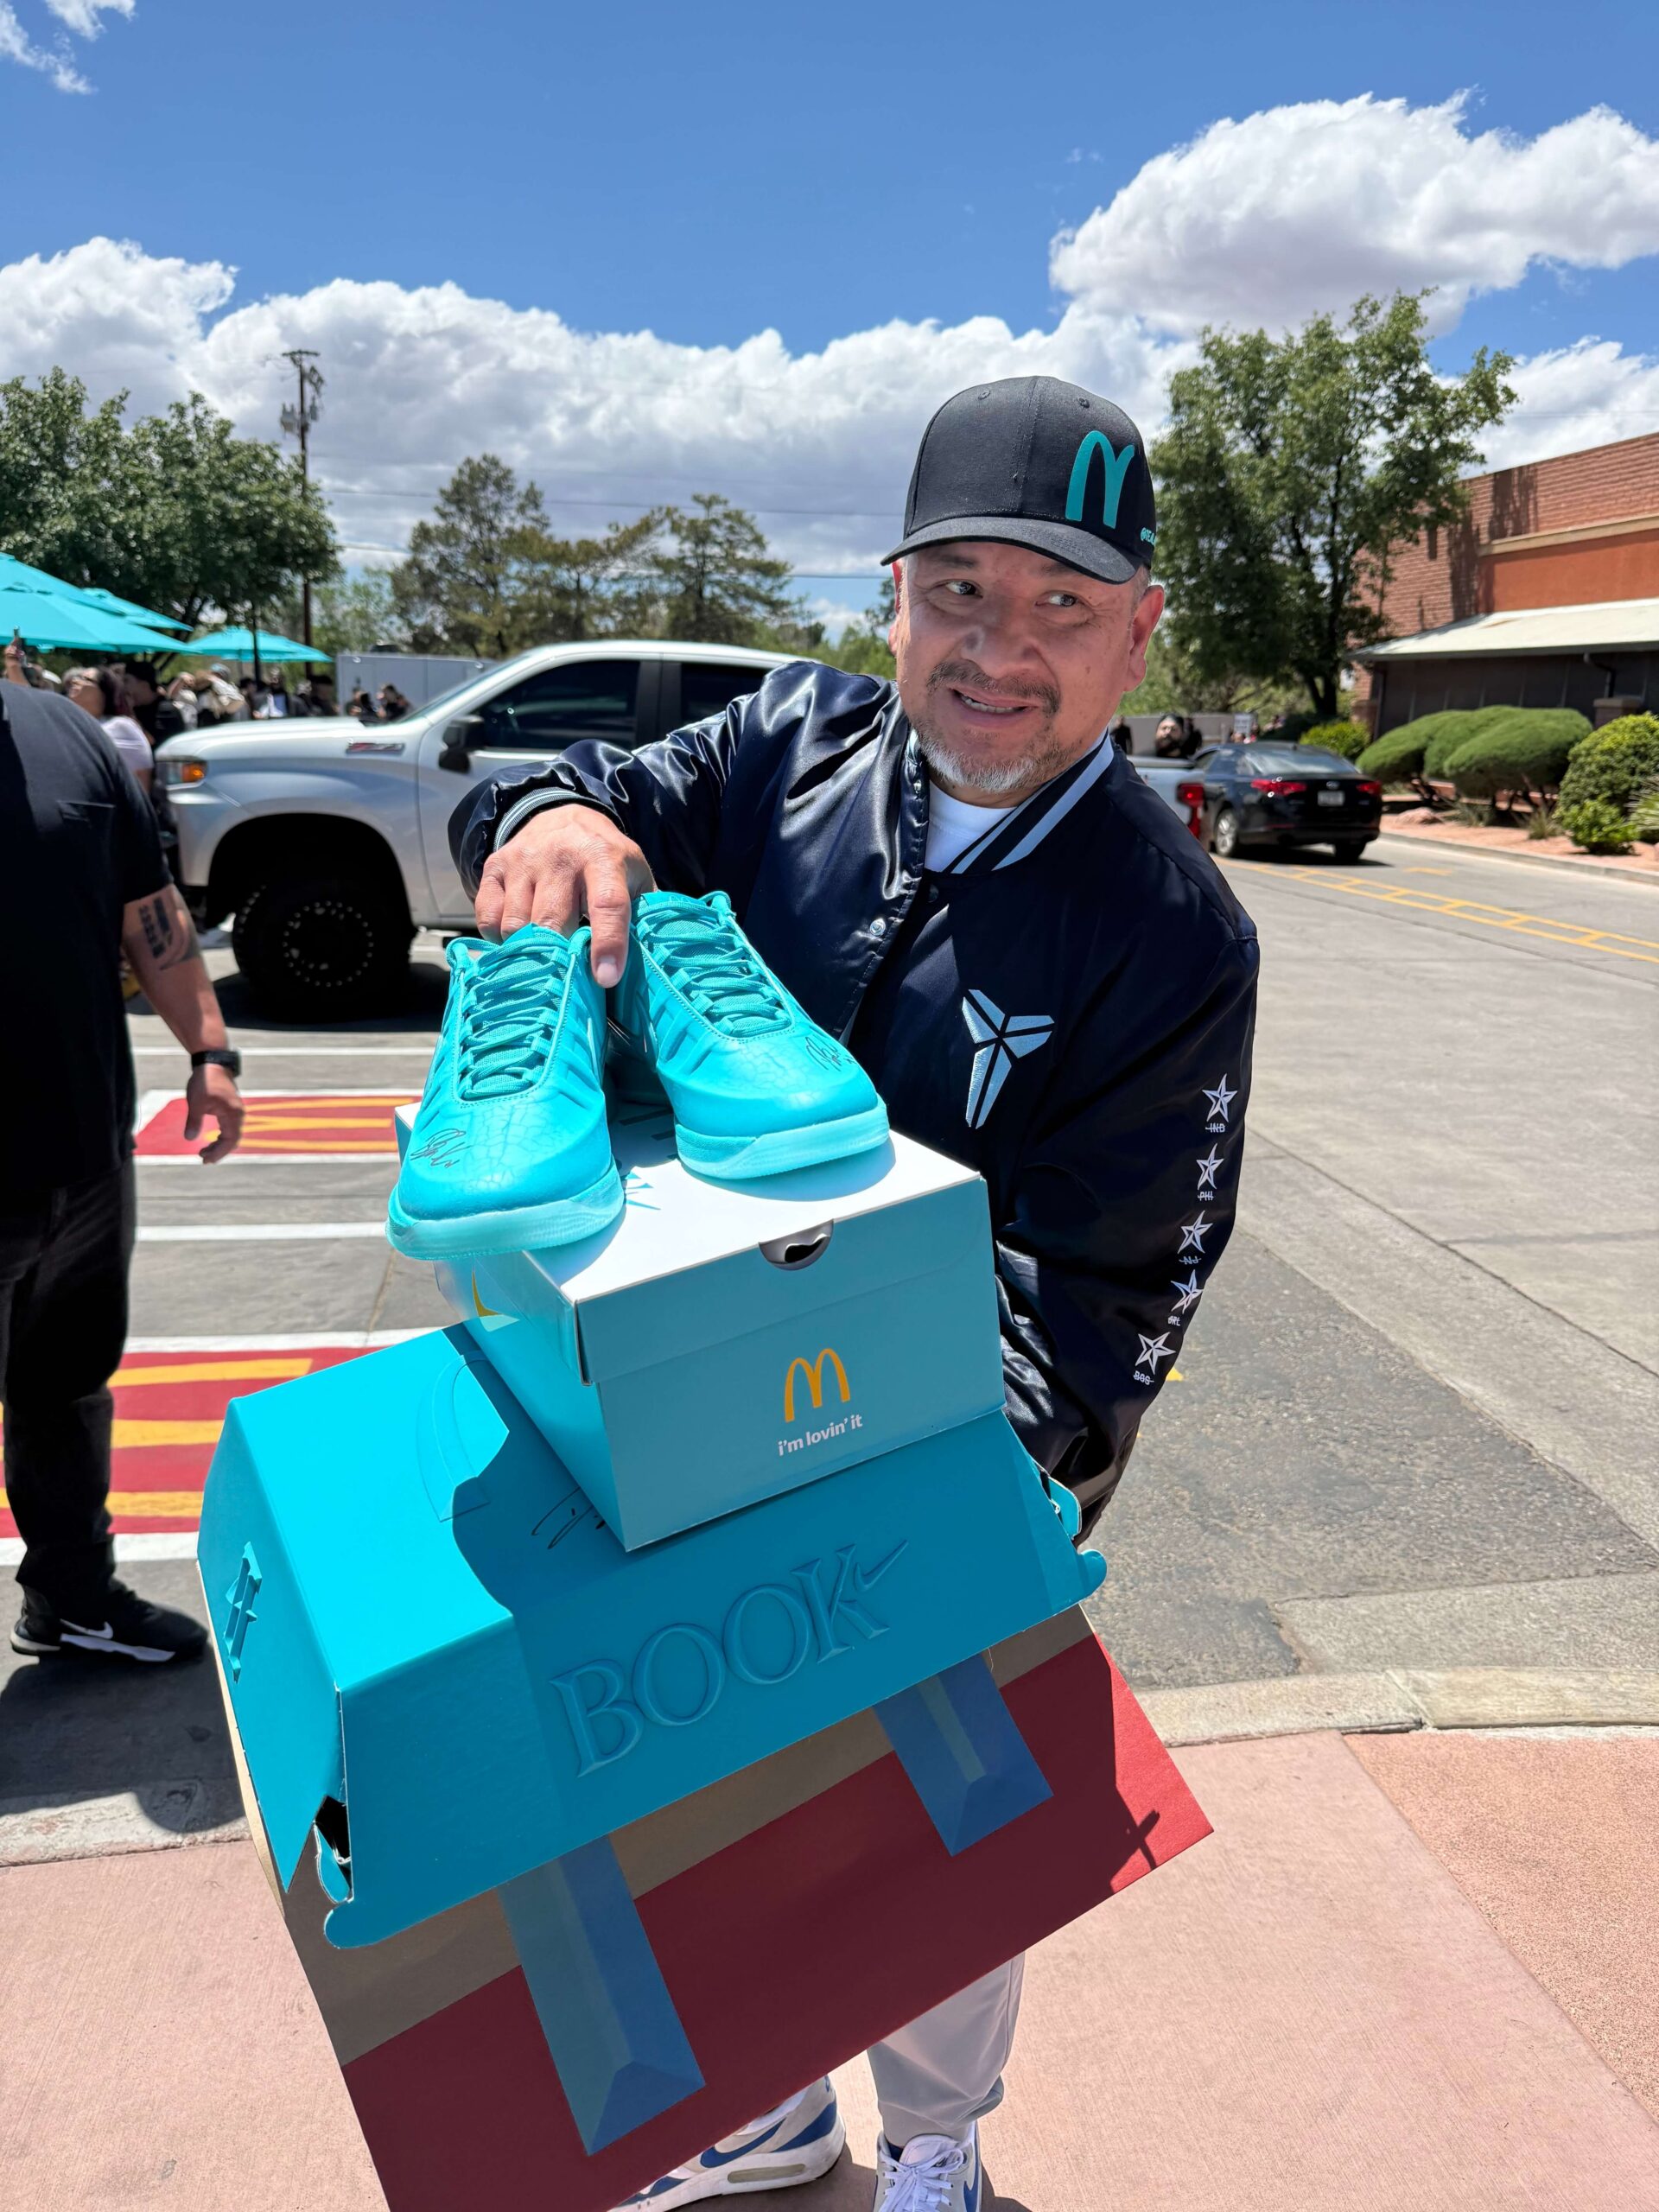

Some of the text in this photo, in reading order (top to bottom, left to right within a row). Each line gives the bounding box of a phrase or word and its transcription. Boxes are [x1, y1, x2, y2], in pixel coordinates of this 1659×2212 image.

[1198, 1191, 1214, 1201] PHI
[778, 1413, 863, 1457] i'm lovin' it
[548, 1542, 891, 1778] BOOK
